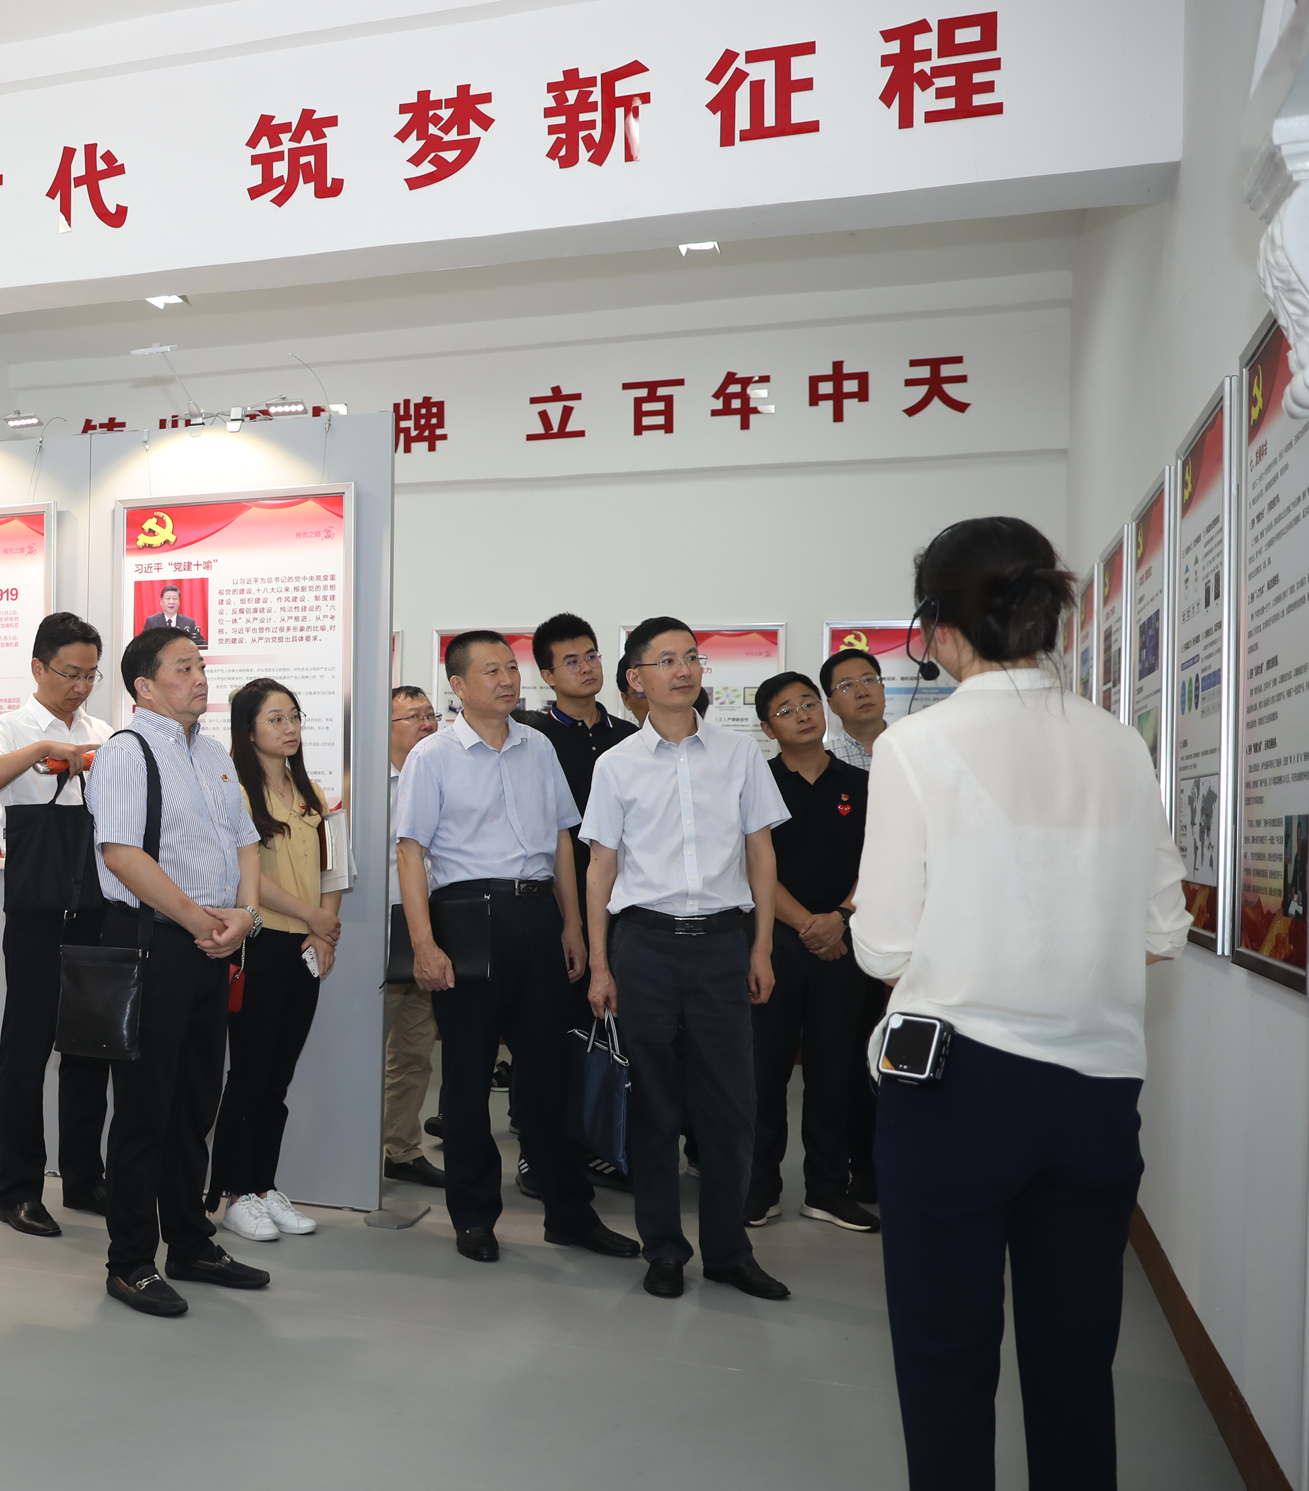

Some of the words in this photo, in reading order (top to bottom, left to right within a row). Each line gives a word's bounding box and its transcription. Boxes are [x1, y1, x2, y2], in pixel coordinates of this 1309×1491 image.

[245, 11, 1003, 207] 筑梦新征程
[526, 355, 971, 441] 立百年中天
